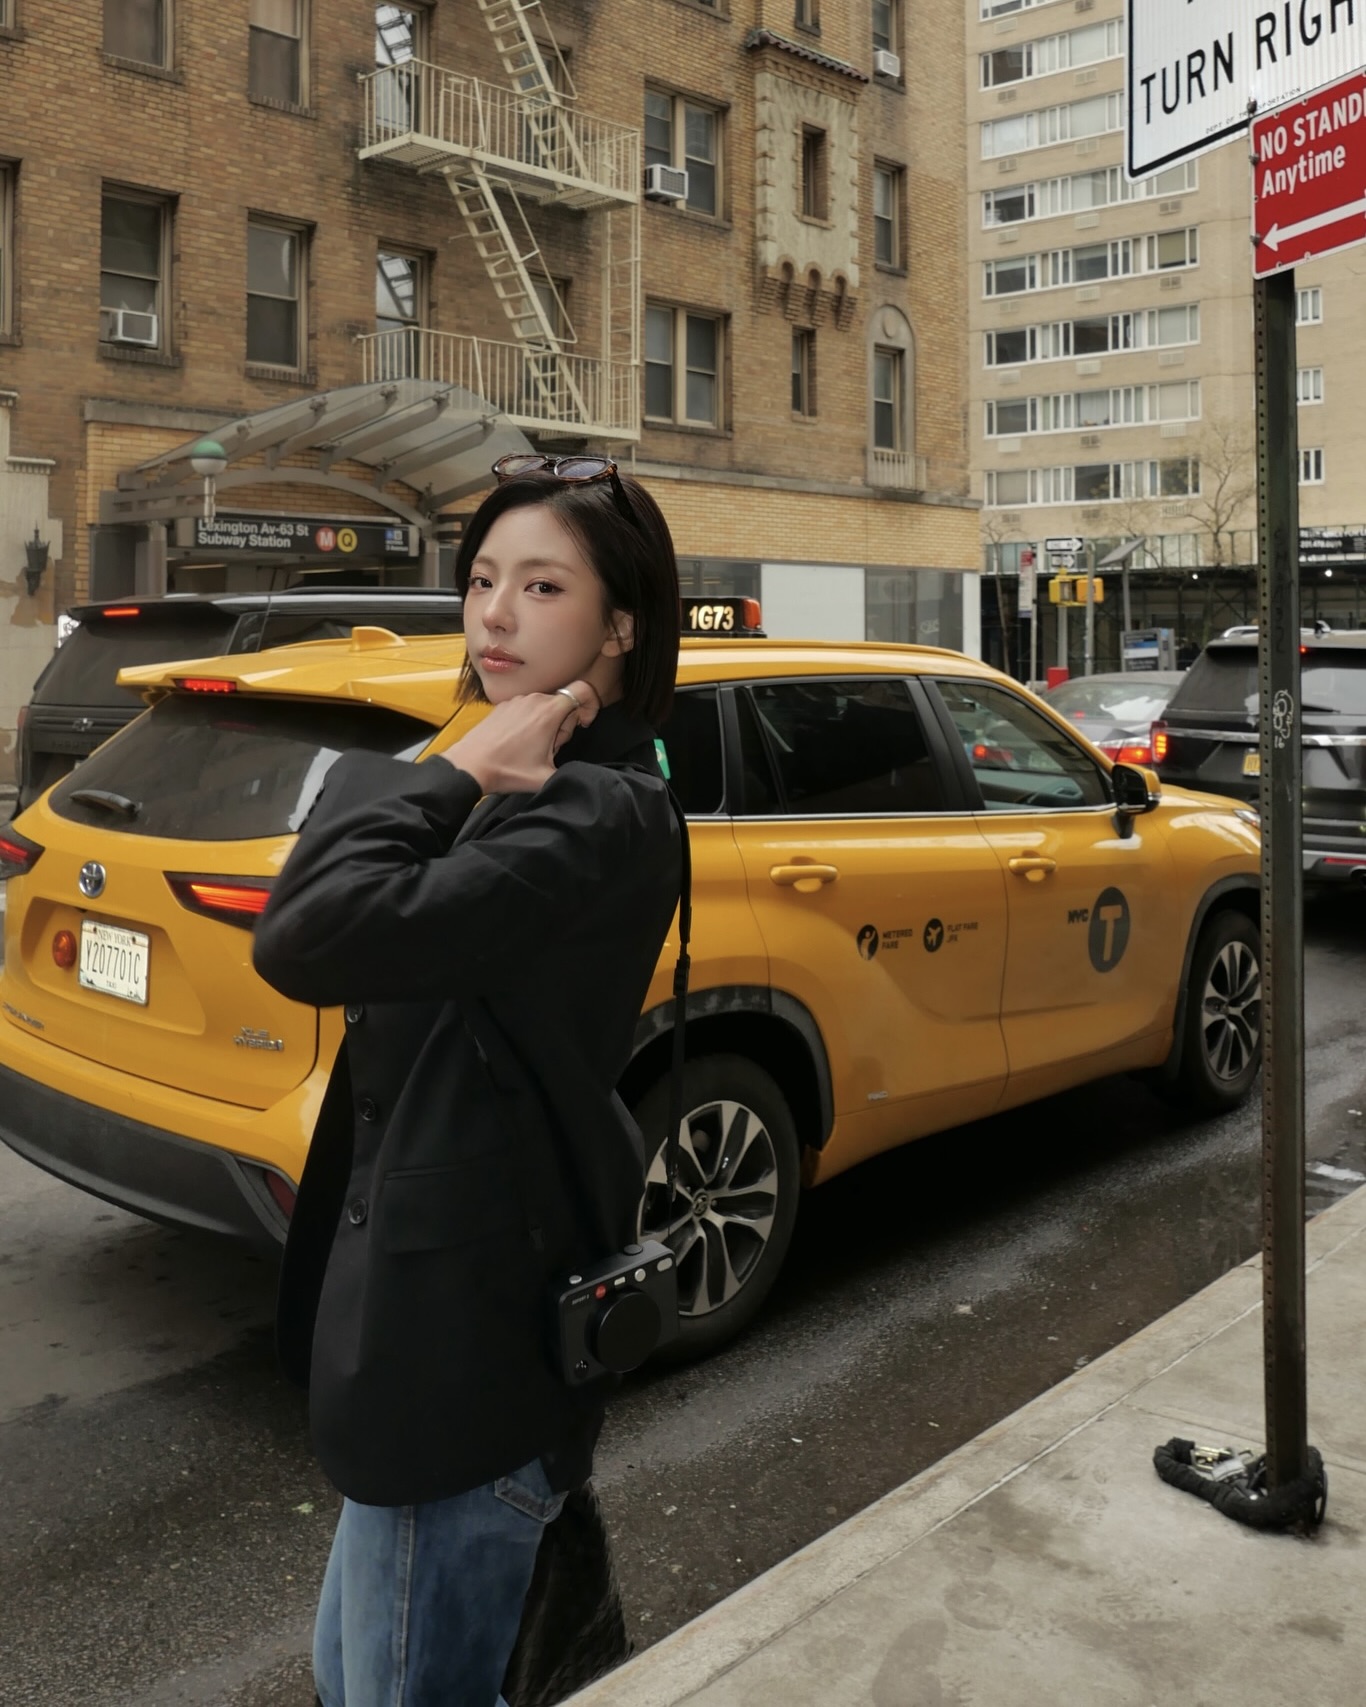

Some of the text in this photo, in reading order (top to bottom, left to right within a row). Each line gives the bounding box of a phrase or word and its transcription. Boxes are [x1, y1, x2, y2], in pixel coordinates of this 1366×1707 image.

[1140, 32, 1234, 125] TURN
[1259, 126, 1288, 162] NO
[1261, 145, 1346, 199] Anytime
[197, 519, 309, 536] Lexington Av-63 St
[198, 532, 291, 548] Subway Station
[320, 531, 353, 547] M Q
[689, 605, 734, 630] 1G73
[1068, 908, 1089, 924] NYC
[883, 929, 913, 939] METERED
[947, 922, 978, 933] FLAT FARE
[97, 929, 131, 947] NEW YORK
[882, 941, 899, 950] FARE
[86, 939, 141, 985] Y207701C
